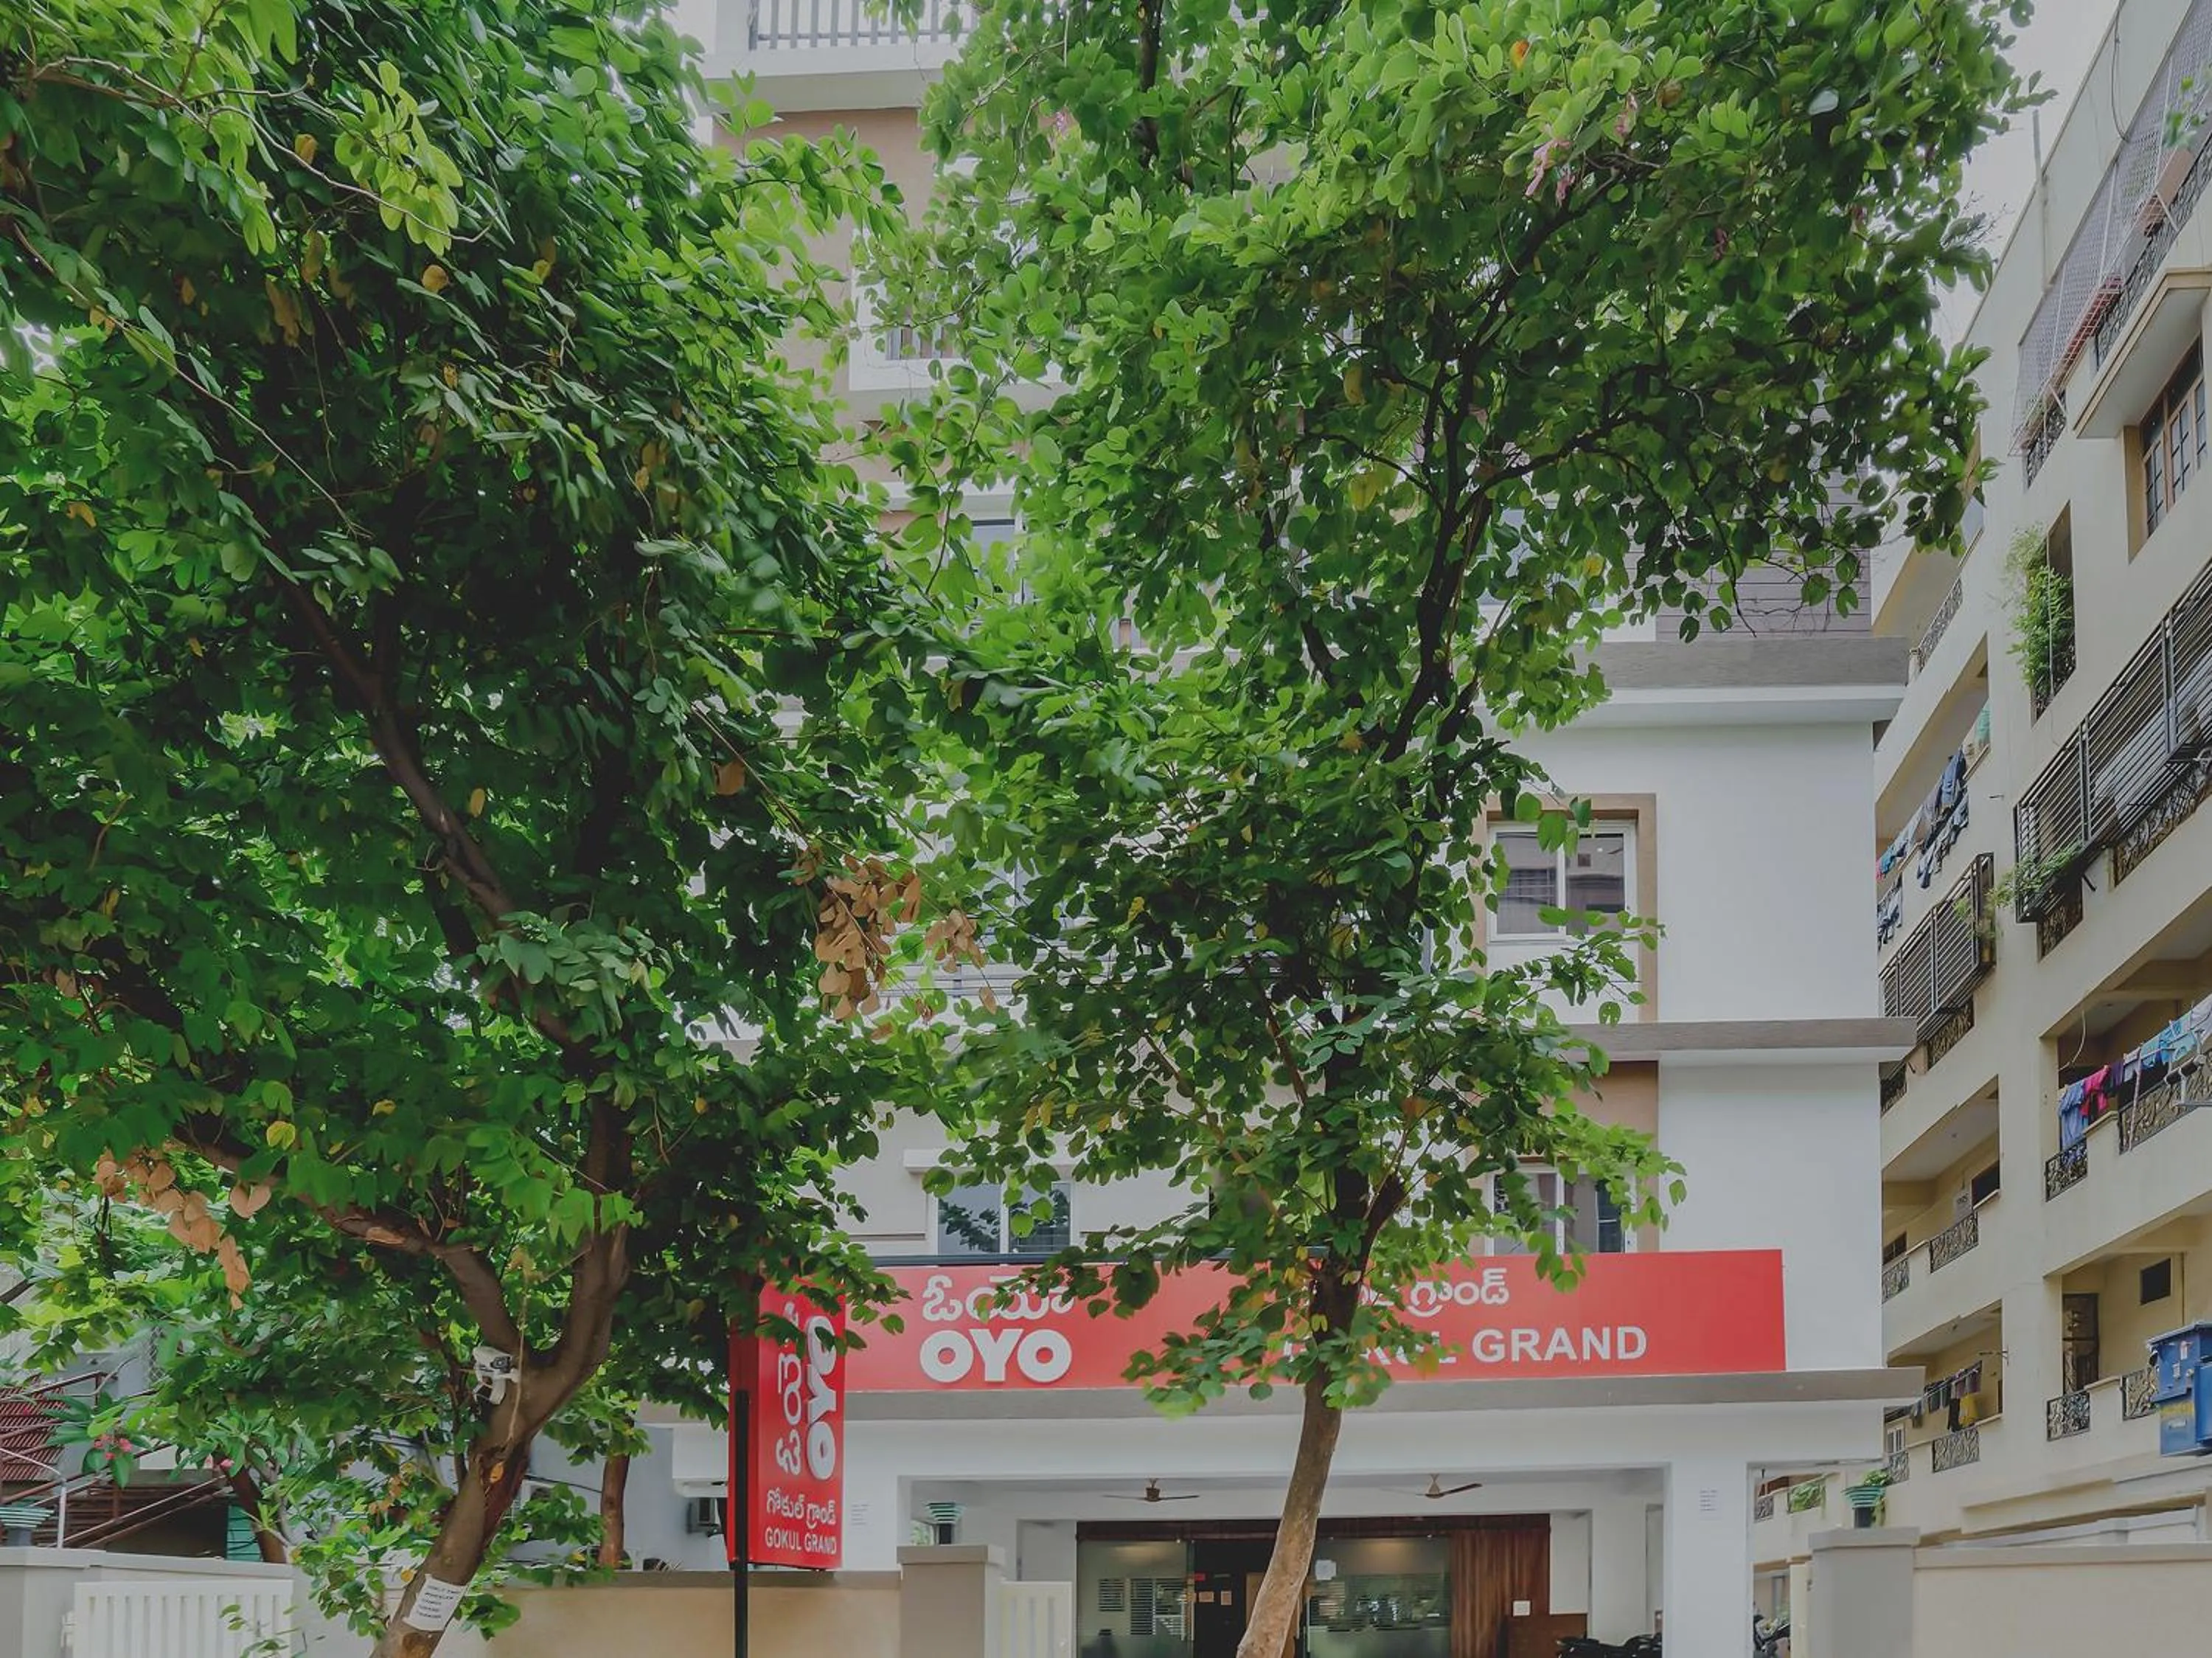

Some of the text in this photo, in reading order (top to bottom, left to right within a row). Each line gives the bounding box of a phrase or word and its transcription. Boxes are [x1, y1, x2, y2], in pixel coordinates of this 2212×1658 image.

[919, 1328, 1073, 1383] OYO
[1472, 1325, 1647, 1363] GRAND
[807, 1315, 837, 1480] OYO
[806, 1499, 836, 1530] గ్రాండ్
[765, 1527, 837, 1555] GOKUL GRAND
